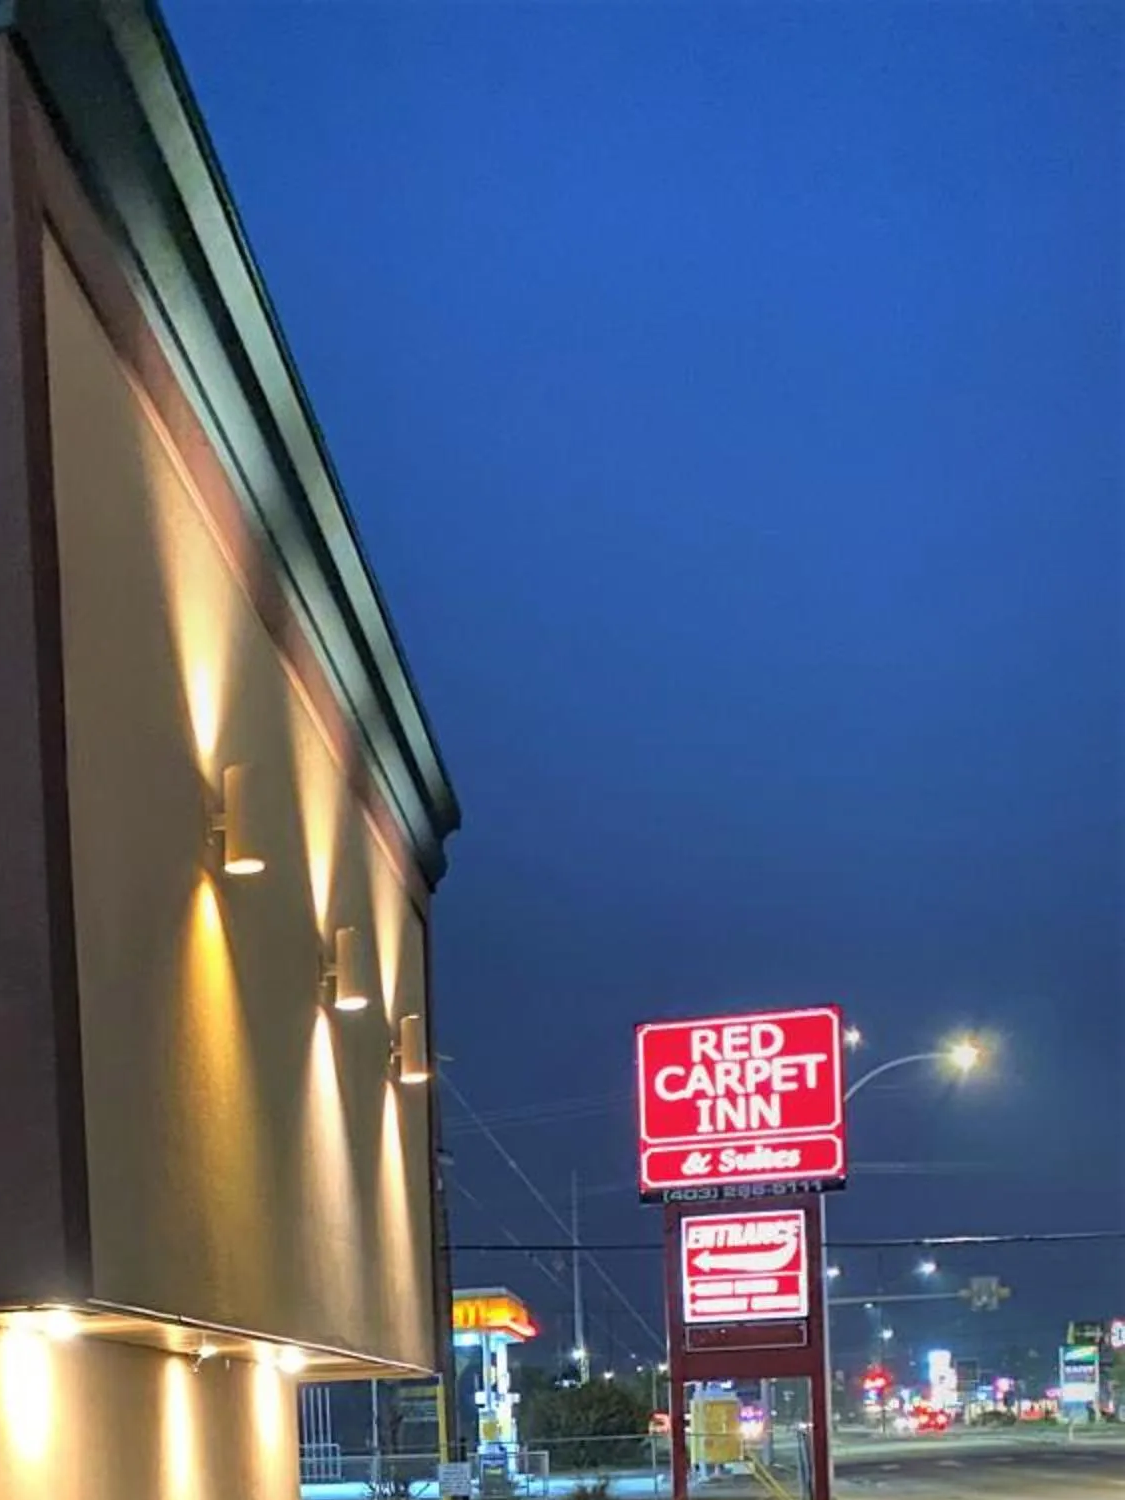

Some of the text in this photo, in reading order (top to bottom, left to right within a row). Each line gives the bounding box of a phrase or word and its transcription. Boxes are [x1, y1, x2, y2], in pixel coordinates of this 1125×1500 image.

[690, 1023, 785, 1063] RED
[654, 1053, 828, 1102] CARPET
[696, 1093, 782, 1133] INN
[681, 1145, 801, 1175] & Suites
